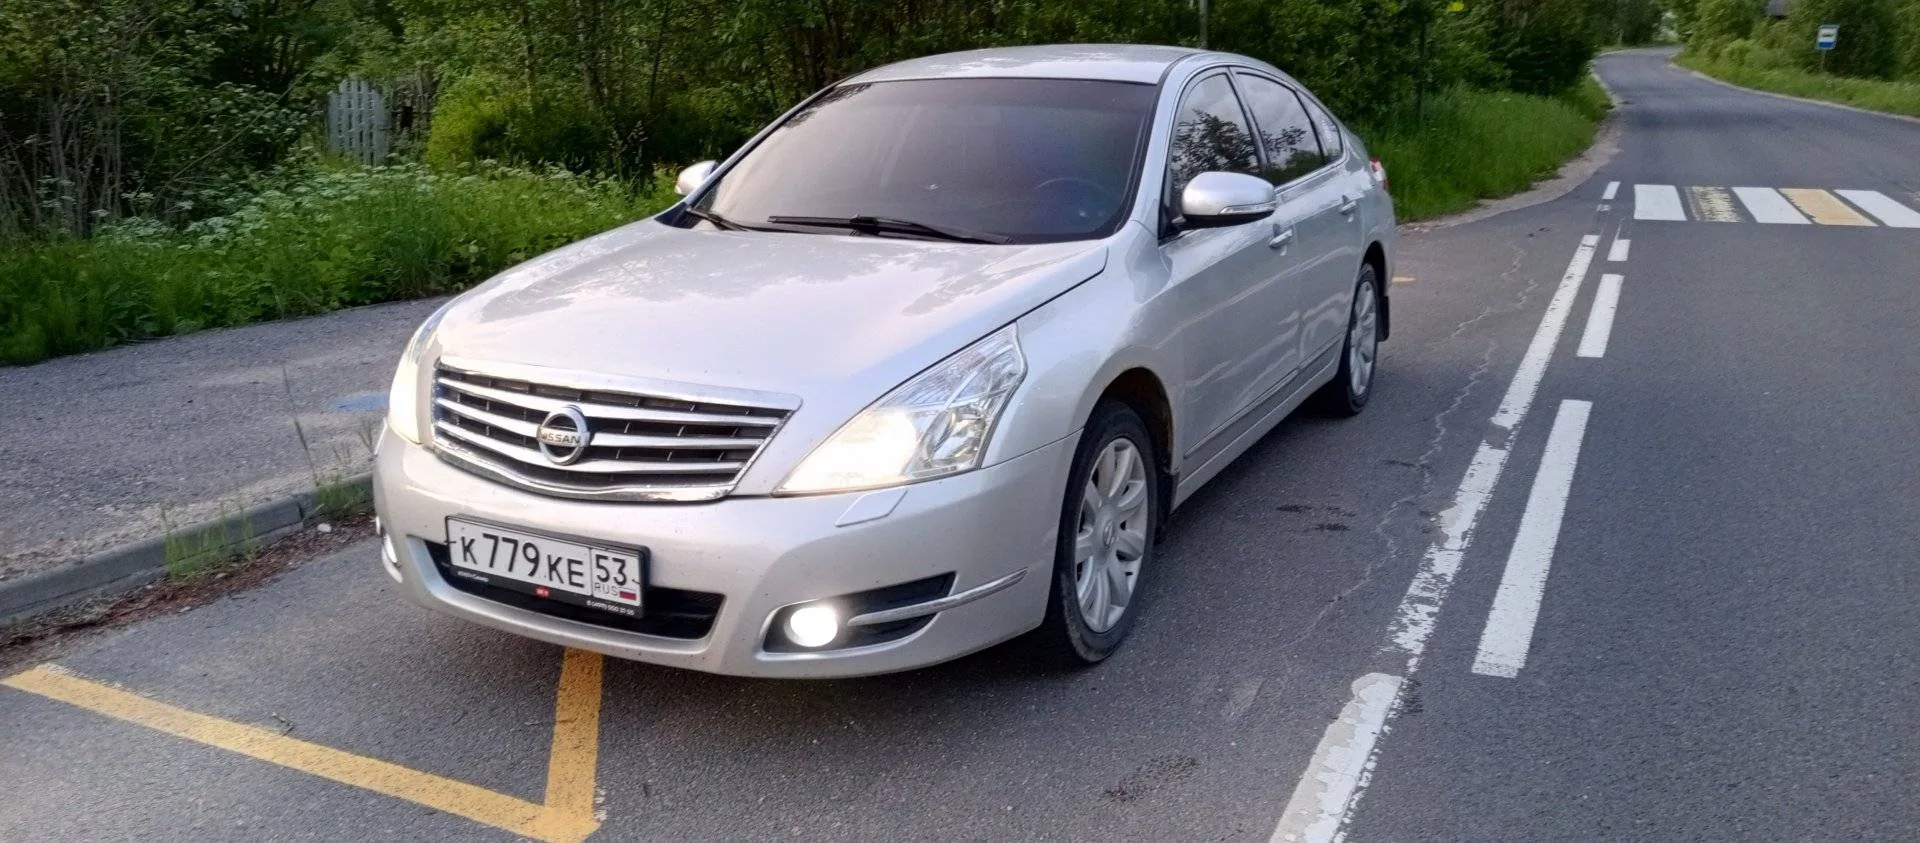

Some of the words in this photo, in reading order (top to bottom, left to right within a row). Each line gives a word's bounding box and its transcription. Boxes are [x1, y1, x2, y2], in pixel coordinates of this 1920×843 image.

[540, 432, 581, 444] NISSAN
[595, 555, 627, 586] 53
[594, 582, 618, 596] RUS
